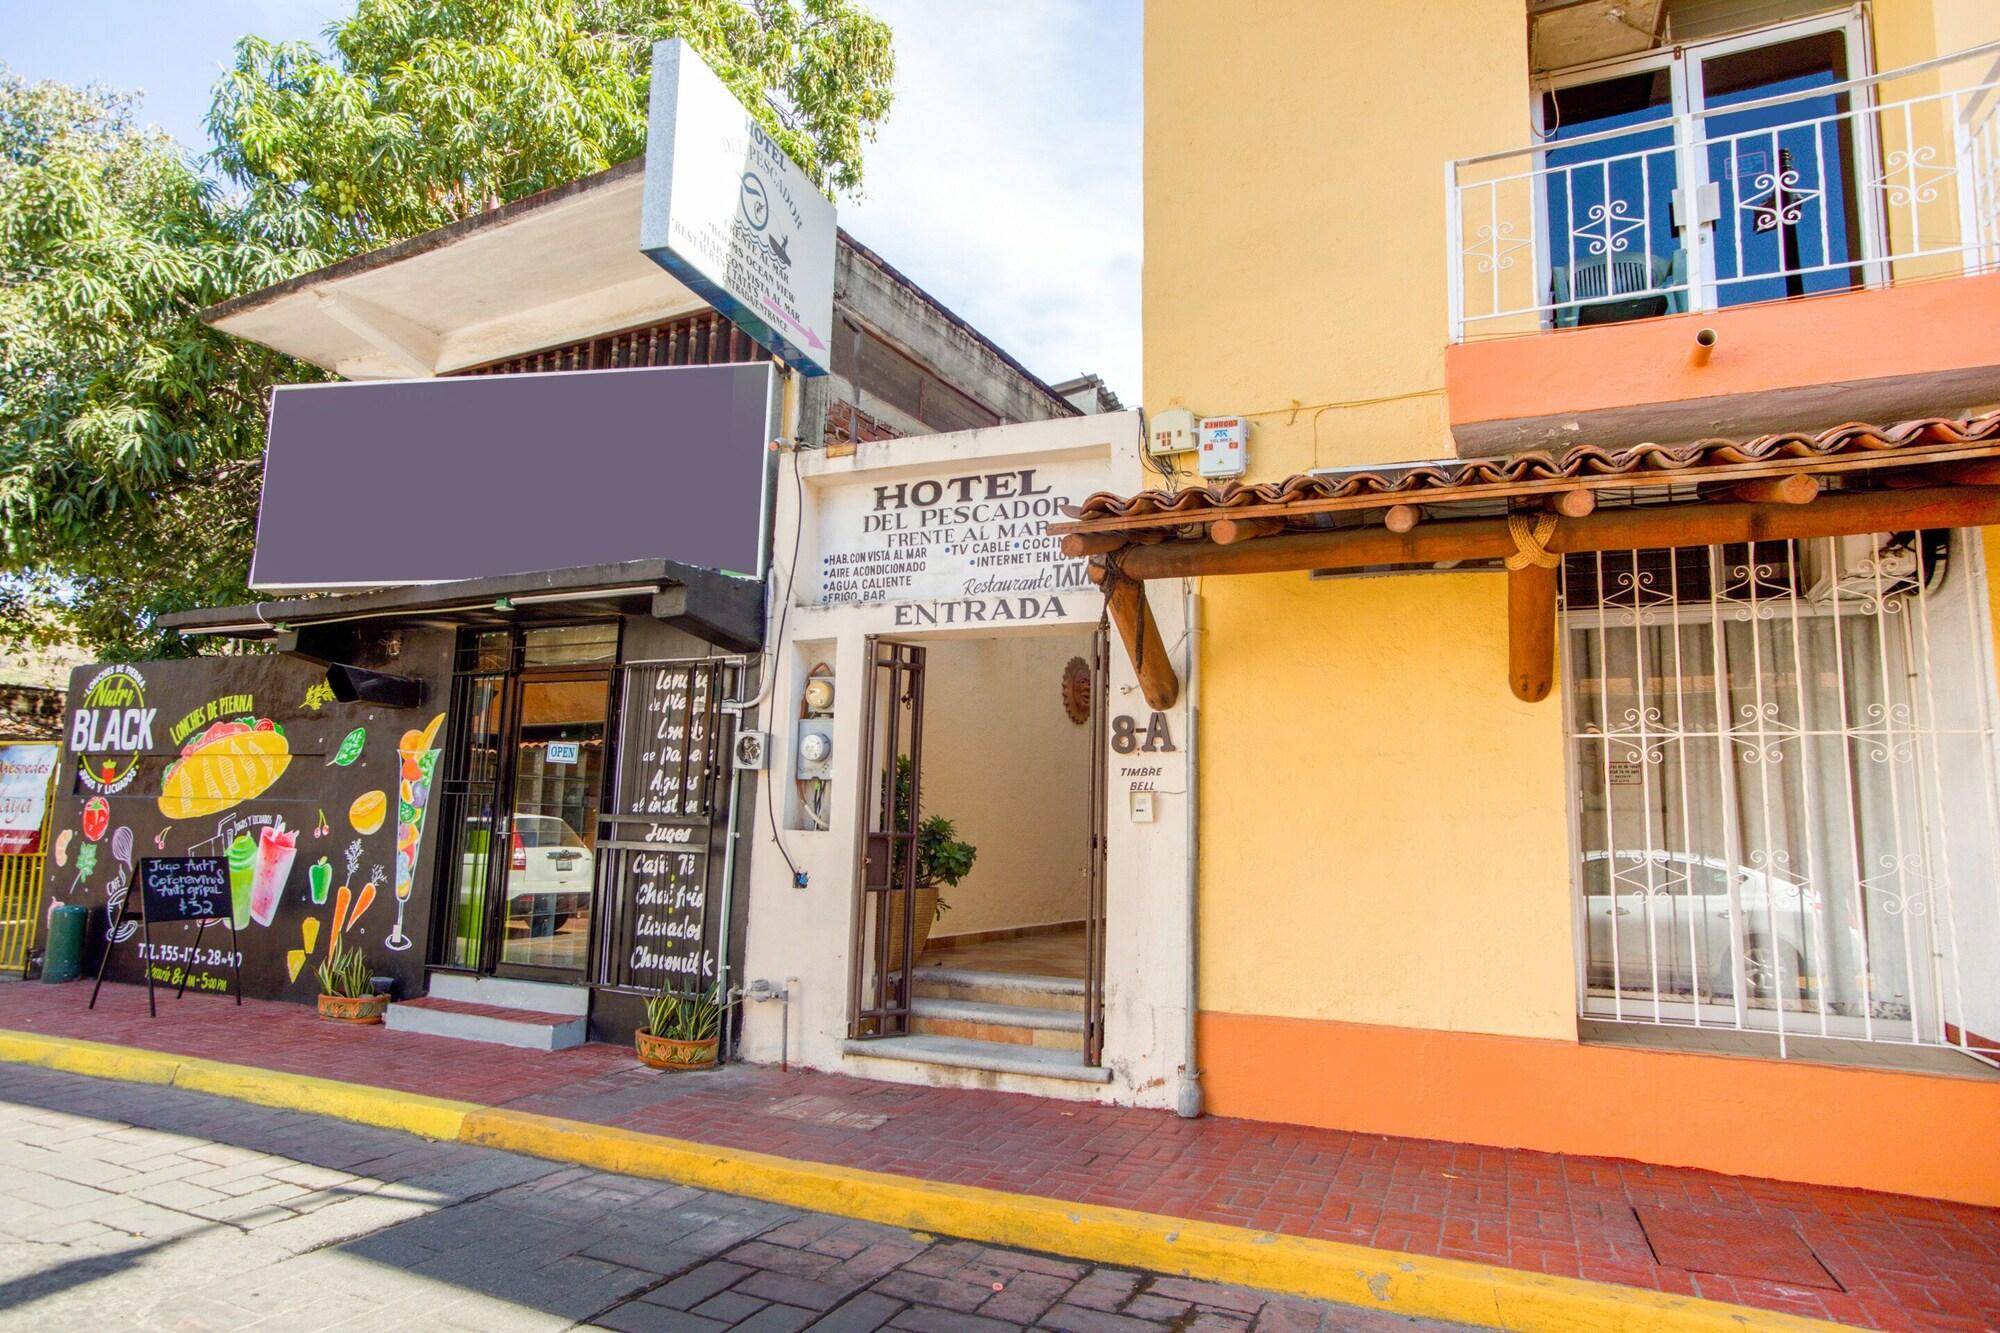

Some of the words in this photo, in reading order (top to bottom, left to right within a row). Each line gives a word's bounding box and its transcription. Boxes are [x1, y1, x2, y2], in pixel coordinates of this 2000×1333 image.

[745, 115, 787, 173] HOTEL
[749, 144, 803, 231] PESCADOR
[746, 255, 774, 285] OCEAN
[776, 280, 796, 305] VIEW
[759, 253, 771, 267] AL
[773, 263, 789, 285] MAR
[746, 270, 770, 298] VISTA
[771, 292, 782, 308] AL
[784, 305, 801, 323] MAR
[873, 469, 1052, 511] HOTEL
[863, 512, 908, 533] DEL
[920, 497, 1070, 528] PESCADOR
[888, 528, 956, 548] FRENTE
[961, 525, 990, 542] AL
[998, 520, 1049, 540] MAR
[951, 543, 970, 556] TV
[972, 540, 1011, 554] CABLE
[867, 549, 891, 562] VISTA
[893, 549, 904, 561] AL
[906, 547, 927, 559] MAR
[976, 552, 1033, 567] INTERNET
[1036, 552, 1051, 563] EN
[828, 580, 858, 592] AGUA
[862, 575, 912, 590] CALIENTE
[829, 567, 850, 579] AIRE
[852, 560, 927, 577] ACONDICIONADO
[963, 568, 1053, 597] Restaurante
[863, 589, 886, 601] BAR
[895, 596, 1068, 626] ENTRADA
[85, 665, 115, 696] LONCHES
[116, 664, 126, 673] DE
[125, 665, 147, 689] PIERNA
[91, 678, 136, 707] Nutri
[70, 708, 158, 752] BLACK
[169, 706, 207, 746] LONCHES
[207, 700, 219, 721] DE
[219, 694, 254, 716] PIERNA
[1111, 712, 1176, 754] 8-A
[550, 745, 576, 759] OPEN
[1120, 767, 1163, 777] TIMBRE
[1130, 781, 1154, 791] BELL
[645, 823, 692, 844] Jugos
[149, 859, 181, 873] Jugo
